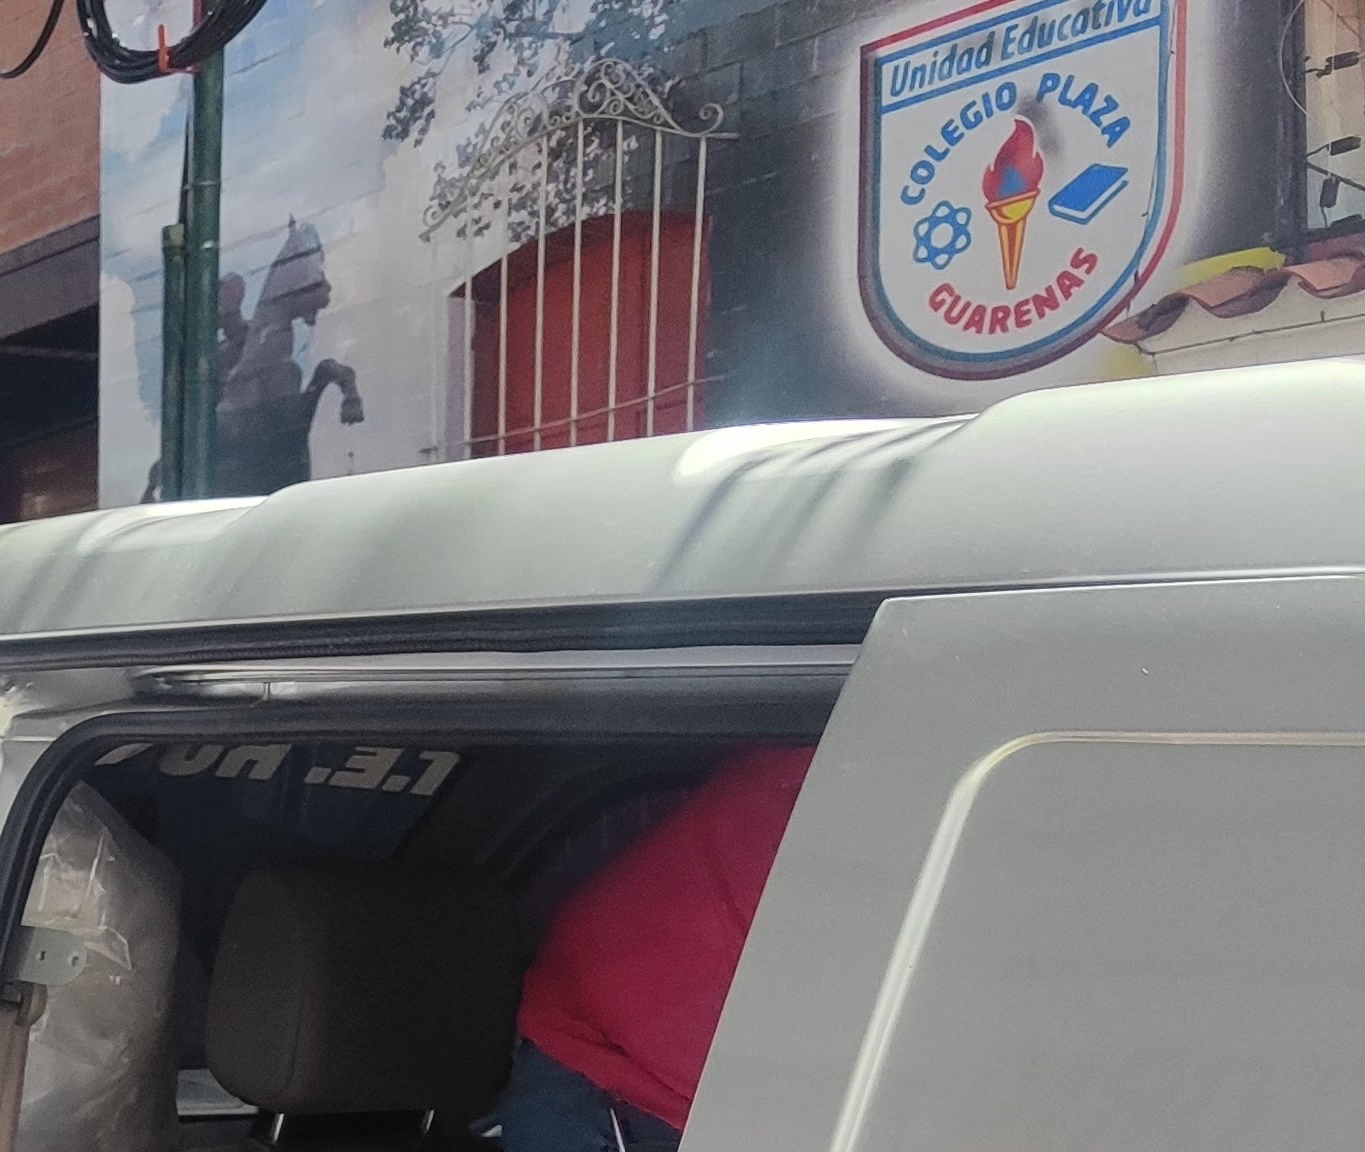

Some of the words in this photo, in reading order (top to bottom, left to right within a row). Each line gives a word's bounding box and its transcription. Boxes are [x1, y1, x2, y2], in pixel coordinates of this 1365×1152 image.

[890, 30, 993, 98] Unidad
[1000, 0, 1153, 62] Educativa
[901, 81, 1018, 205] COLEGIO
[1036, 72, 1132, 149] PLAZA
[929, 247, 1099, 334] GUARENAS
